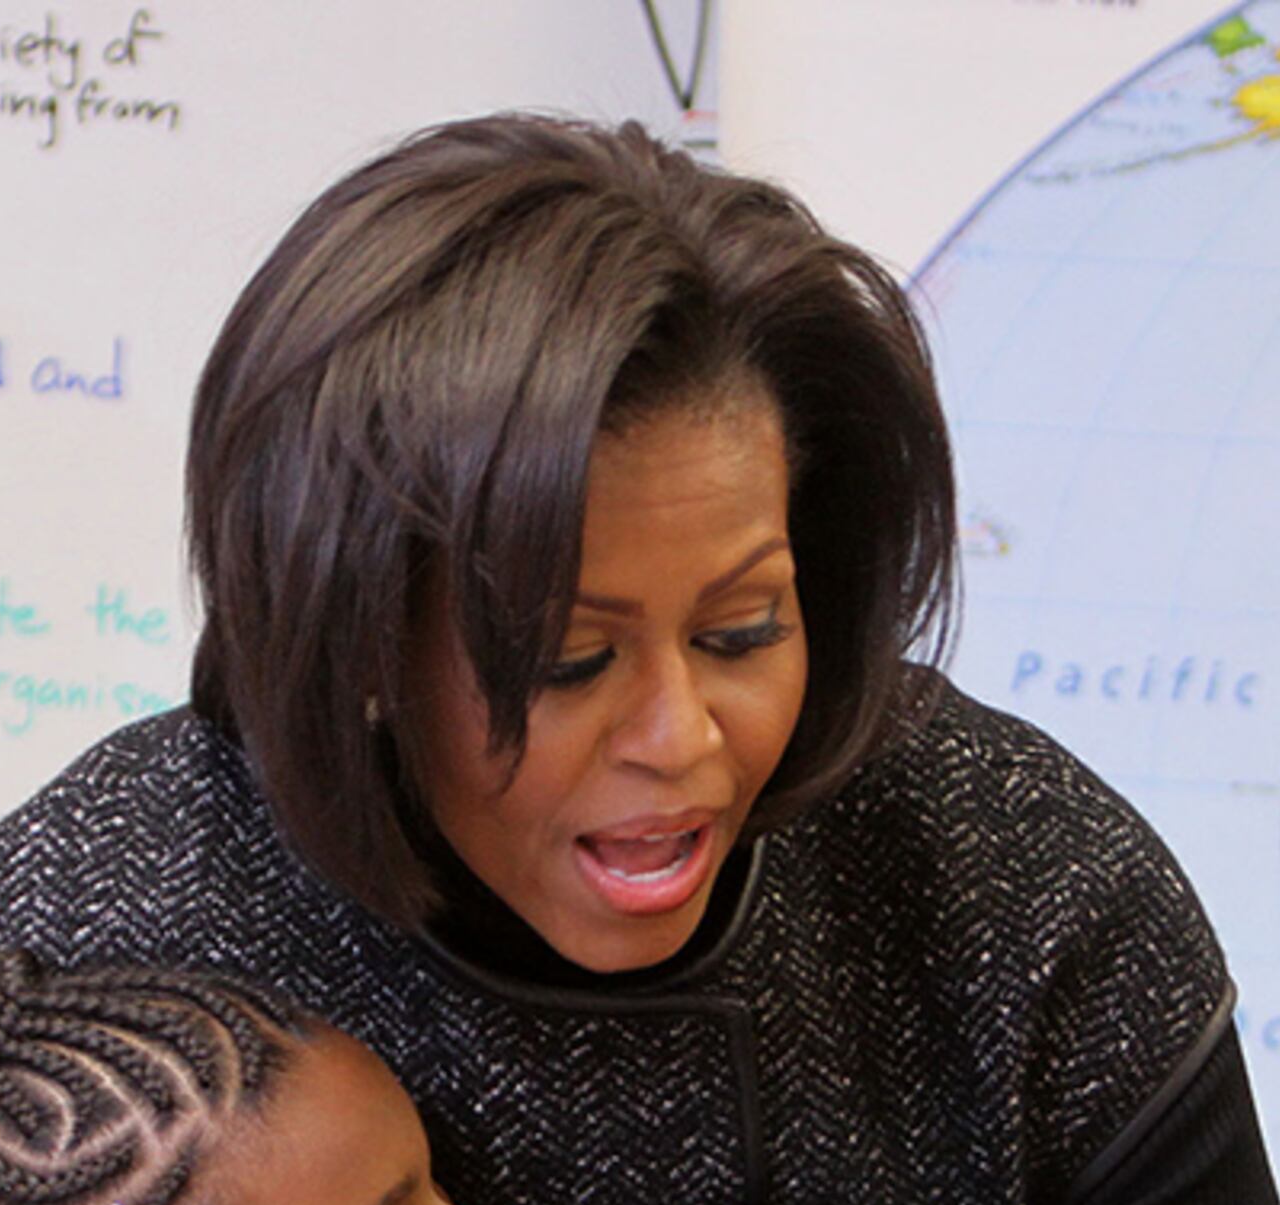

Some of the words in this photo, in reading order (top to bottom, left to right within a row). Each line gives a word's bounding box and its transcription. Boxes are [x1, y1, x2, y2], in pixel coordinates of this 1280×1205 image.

[102, 8, 166, 66] of
[74, 78, 182, 132] from
[86, 598, 174, 646] the
[1010, 650, 1262, 708] Pacific
